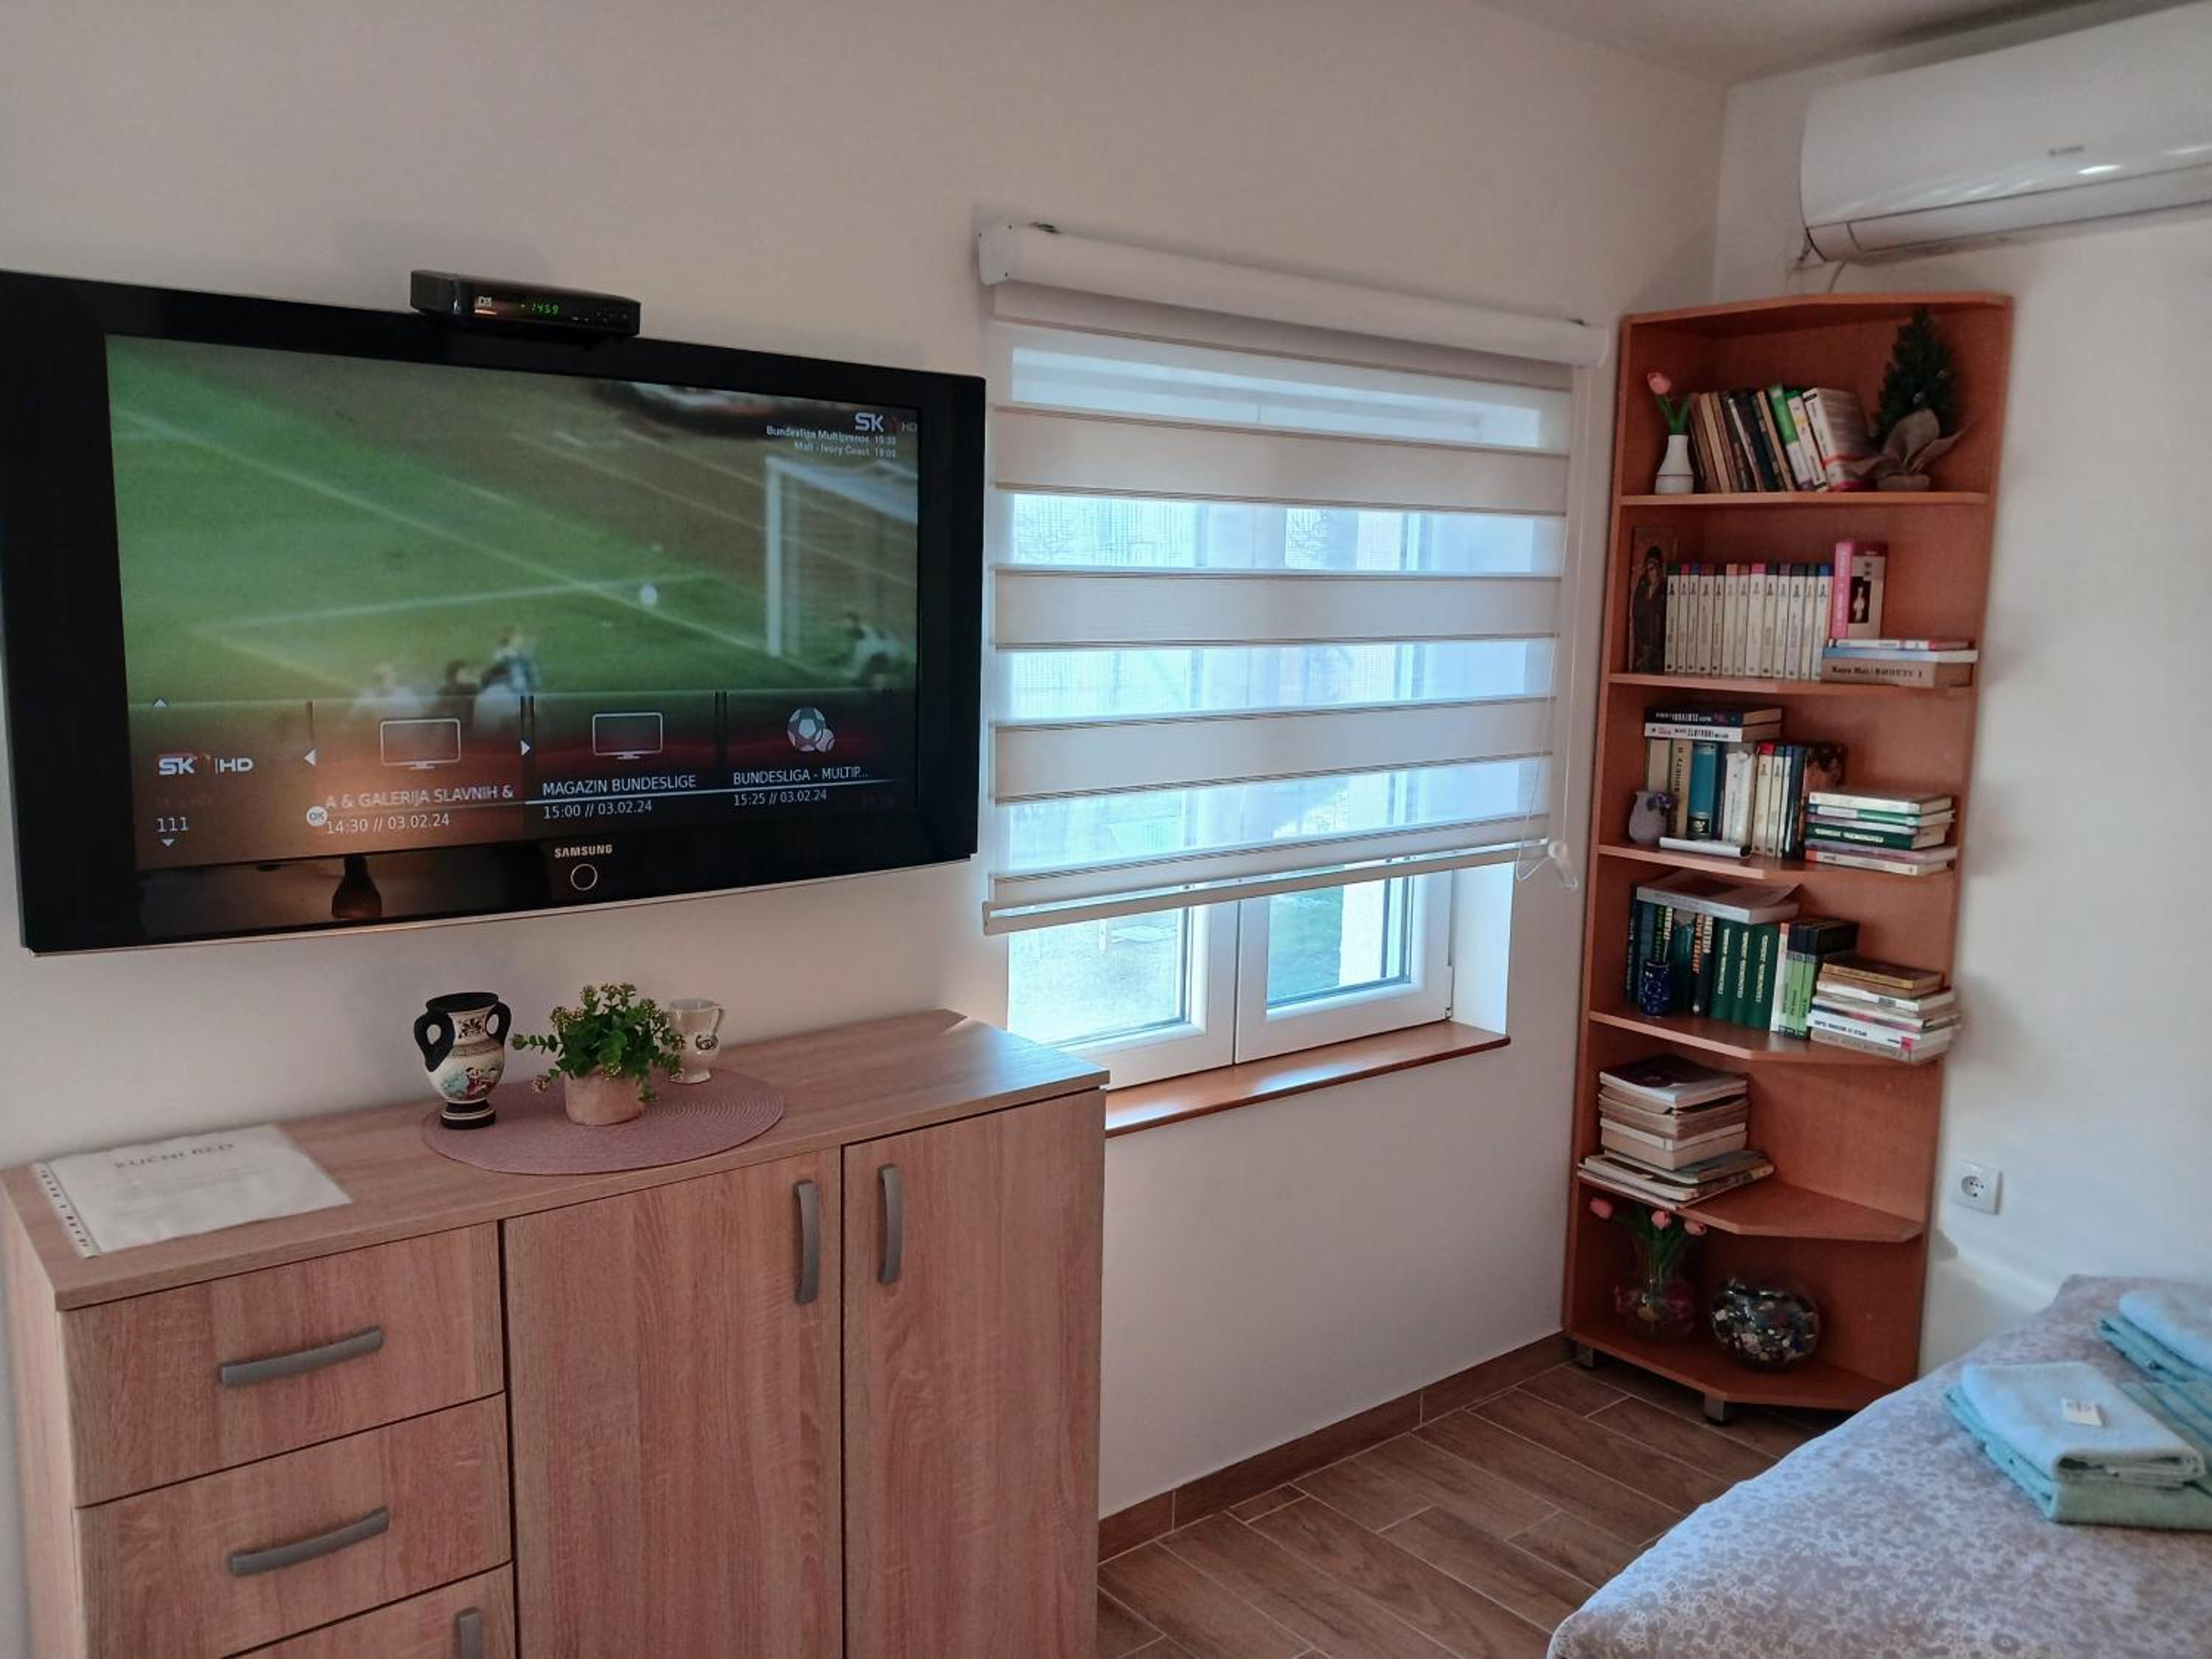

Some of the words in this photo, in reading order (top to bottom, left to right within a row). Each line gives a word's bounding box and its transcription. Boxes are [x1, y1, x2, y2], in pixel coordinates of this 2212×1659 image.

[855, 412, 884, 432] SK
[766, 425, 816, 439] Bundesliga
[159, 757, 195, 775] SK
[219, 757, 254, 773] HD
[542, 779, 608, 796] MAGAZIN
[611, 774, 697, 793] BUNDESLIGE
[733, 769, 810, 786] BUNDESLIGA
[341, 795, 354, 809] &
[358, 790, 430, 807] GALERIJA
[434, 785, 497, 803] SLAVNIH
[503, 785, 514, 799] &
[734, 793, 765, 806] 15:25
[779, 789, 827, 803] 03.02.24
[543, 804, 580, 819] 15:00
[598, 799, 653, 815] 03.02.24
[157, 816, 189, 833] 111
[326, 818, 368, 834] 14:30
[387, 813, 451, 830] 03.02.24
[554, 844, 613, 859] SAMSUNG
